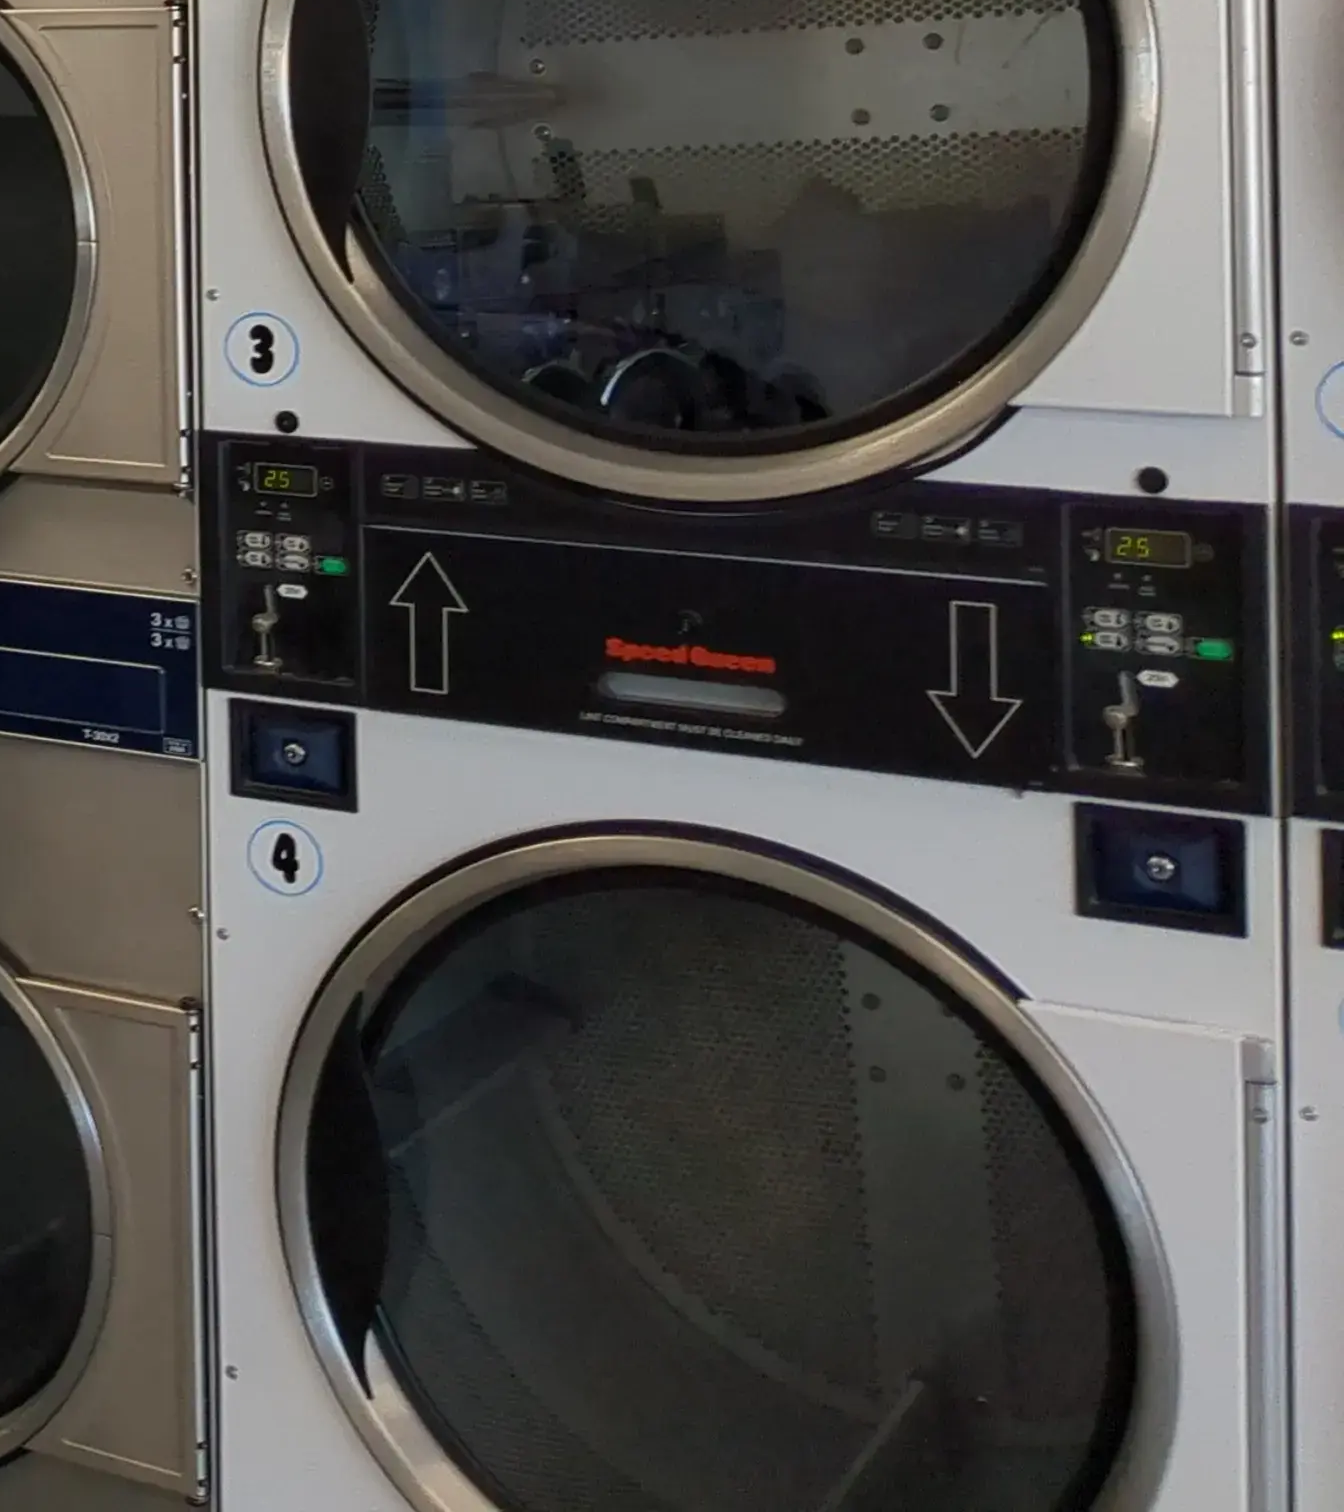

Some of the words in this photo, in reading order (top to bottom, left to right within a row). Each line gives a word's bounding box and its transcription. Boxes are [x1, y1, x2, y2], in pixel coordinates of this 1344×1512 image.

[248, 324, 274, 374] 3
[264, 470, 290, 488] 25
[1116, 536, 1150, 558] 25
[272, 832, 299, 884] 4
